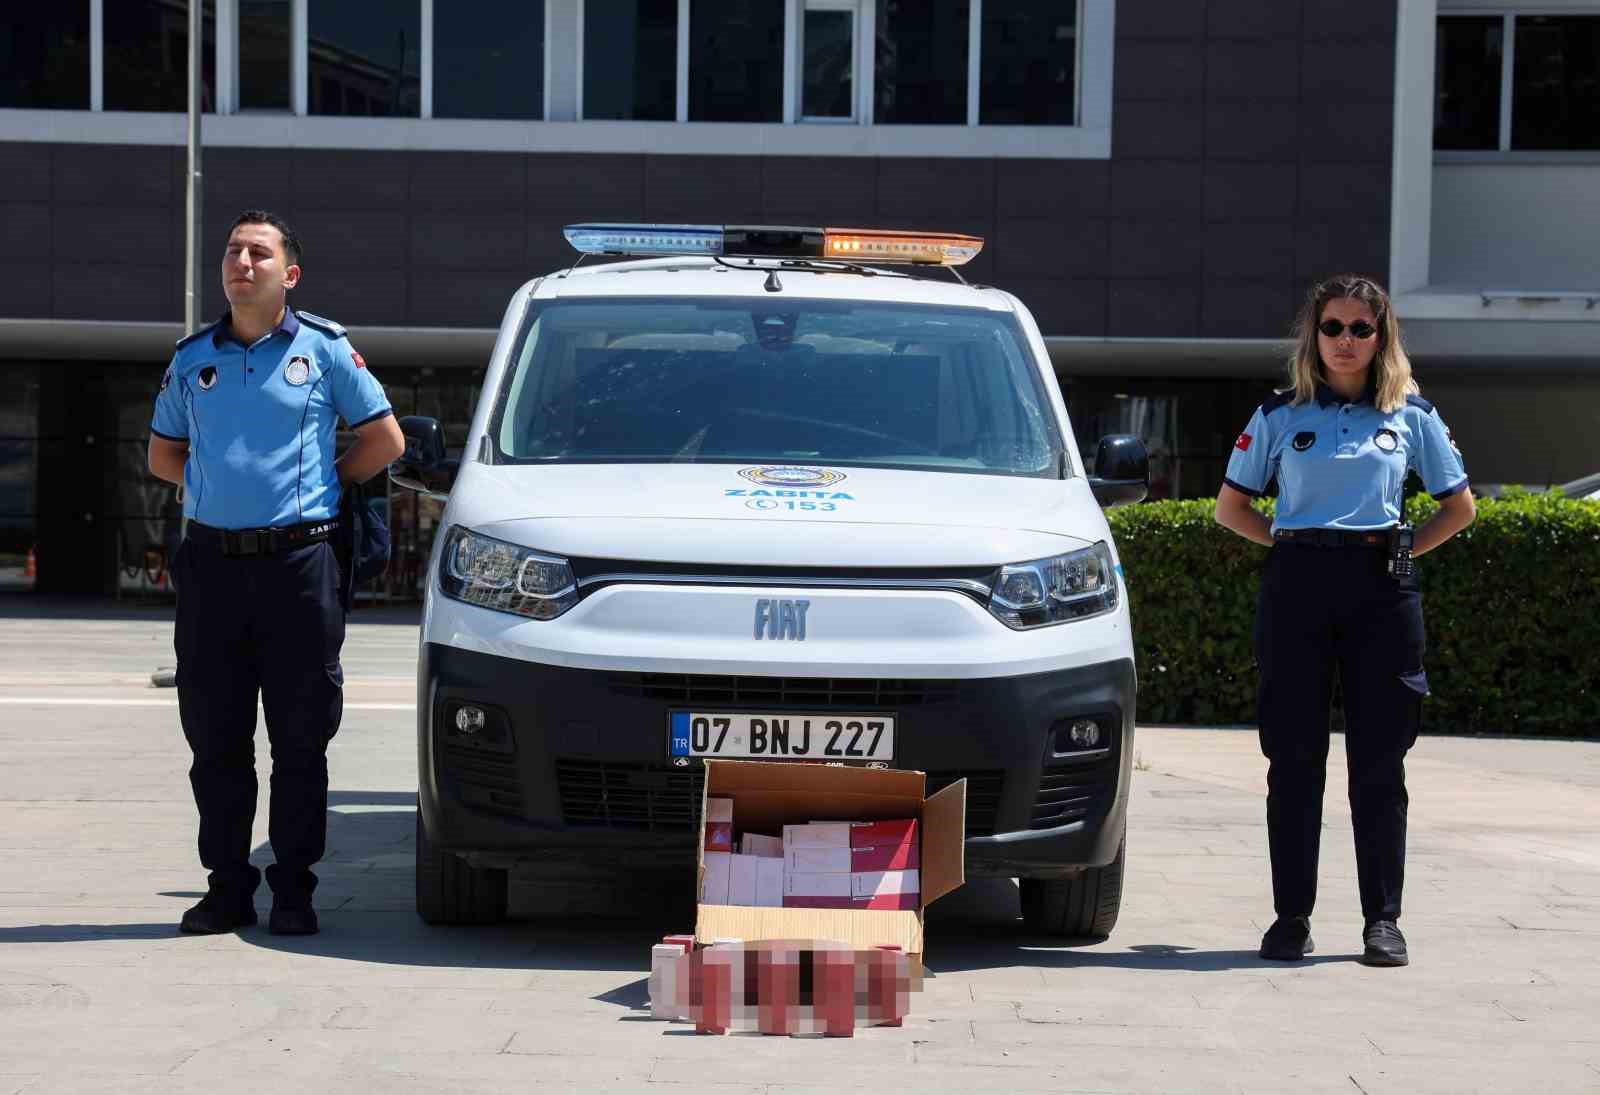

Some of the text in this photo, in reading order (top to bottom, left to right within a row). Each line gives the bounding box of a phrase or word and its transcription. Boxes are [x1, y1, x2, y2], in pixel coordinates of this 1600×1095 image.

[725, 489, 855, 501] ZABITA
[785, 501, 837, 511] 153
[754, 599, 810, 642] FIAT
[673, 738, 688, 749] TR
[692, 718, 885, 757] 07 BNJ 227
